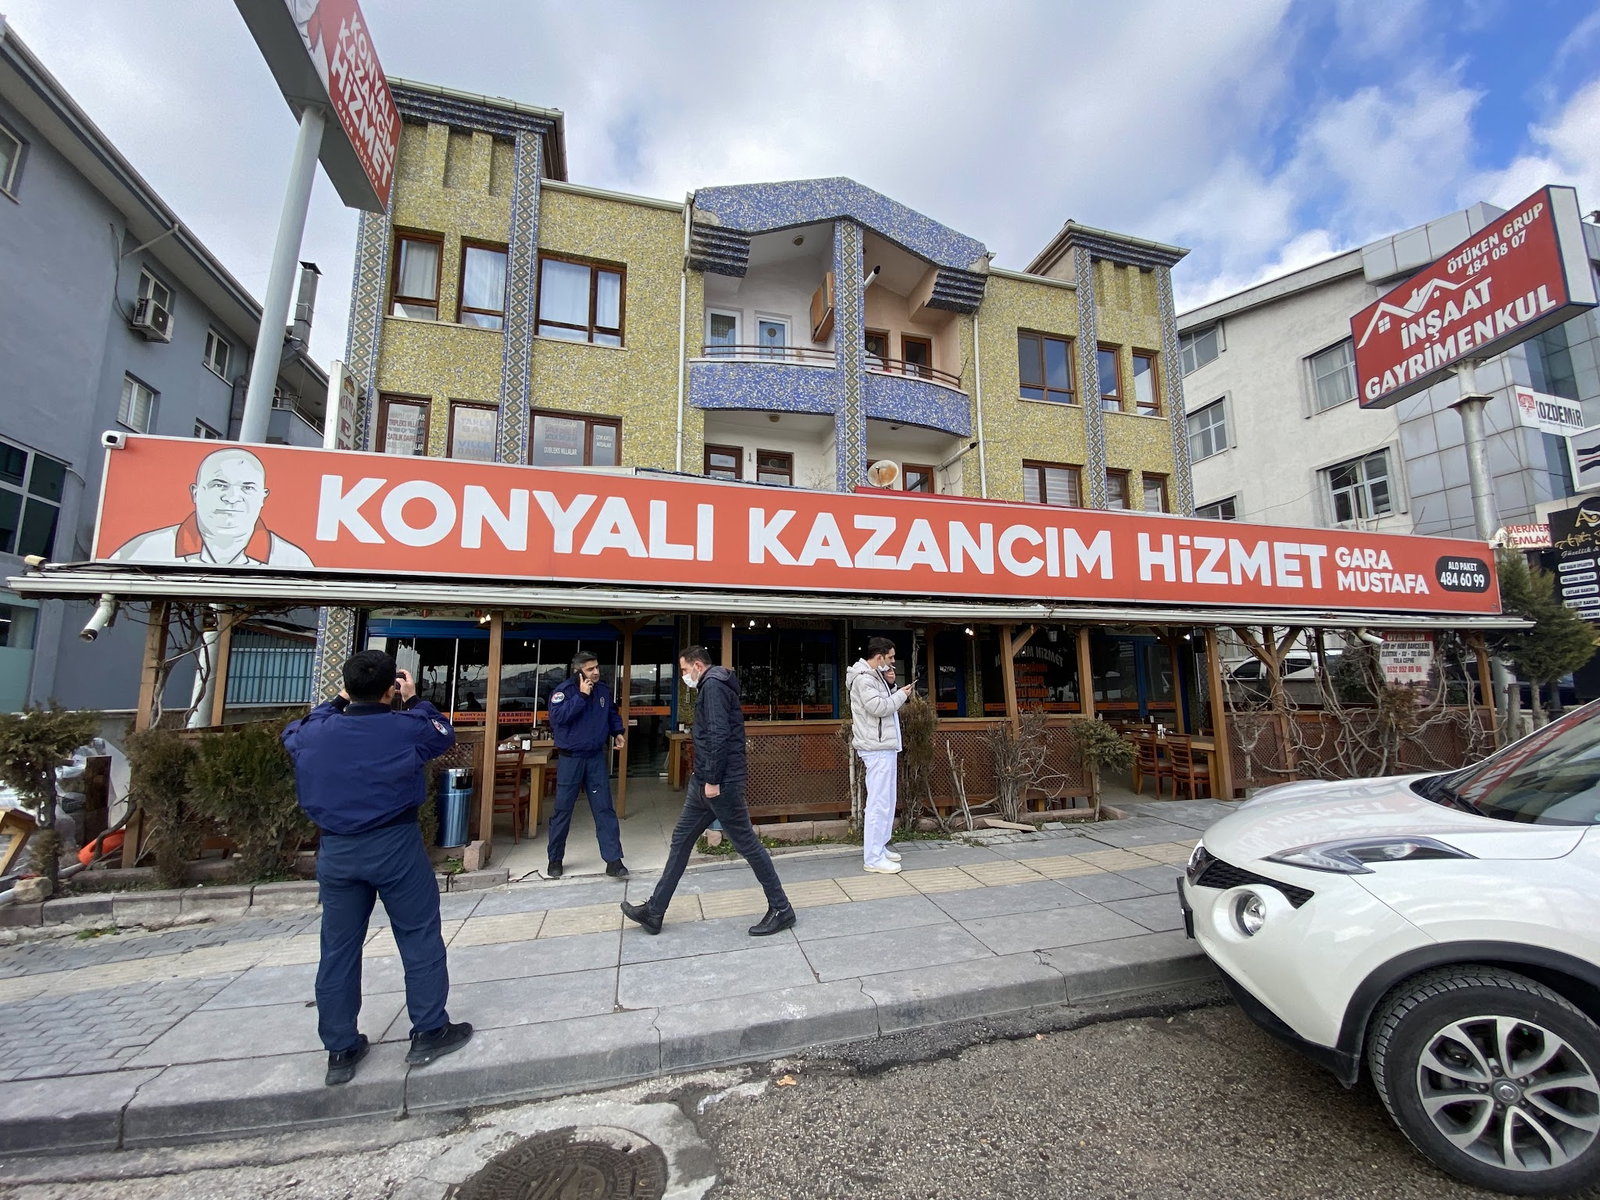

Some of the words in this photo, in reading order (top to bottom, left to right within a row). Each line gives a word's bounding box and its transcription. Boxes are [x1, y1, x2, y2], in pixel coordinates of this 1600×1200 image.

[339, 17, 395, 164] KAZANCIM
[350, 11, 394, 132] KONYALI
[337, 100, 353, 135] GARA
[1447, 232, 1499, 275] ÖTÜKEN
[1502, 202, 1544, 238] GRUP
[1465, 258, 1489, 276] 484
[1492, 244, 1509, 262] 08
[1512, 229, 1527, 249] 07
[1365, 284, 1556, 401] GAYRİMENKUL
[1400, 277, 1492, 350] İNŞAAT
[316, 474, 714, 562] KONYALI
[748, 507, 1114, 580] KAZANCIM
[1335, 547, 1393, 570] GARA
[1336, 570, 1430, 595] MUSTAFA
[1440, 571, 1458, 586] 484
[1460, 572, 1471, 587] 60
[1473, 573, 1485, 588] 99
[1460, 562, 1478, 572] PAKET
